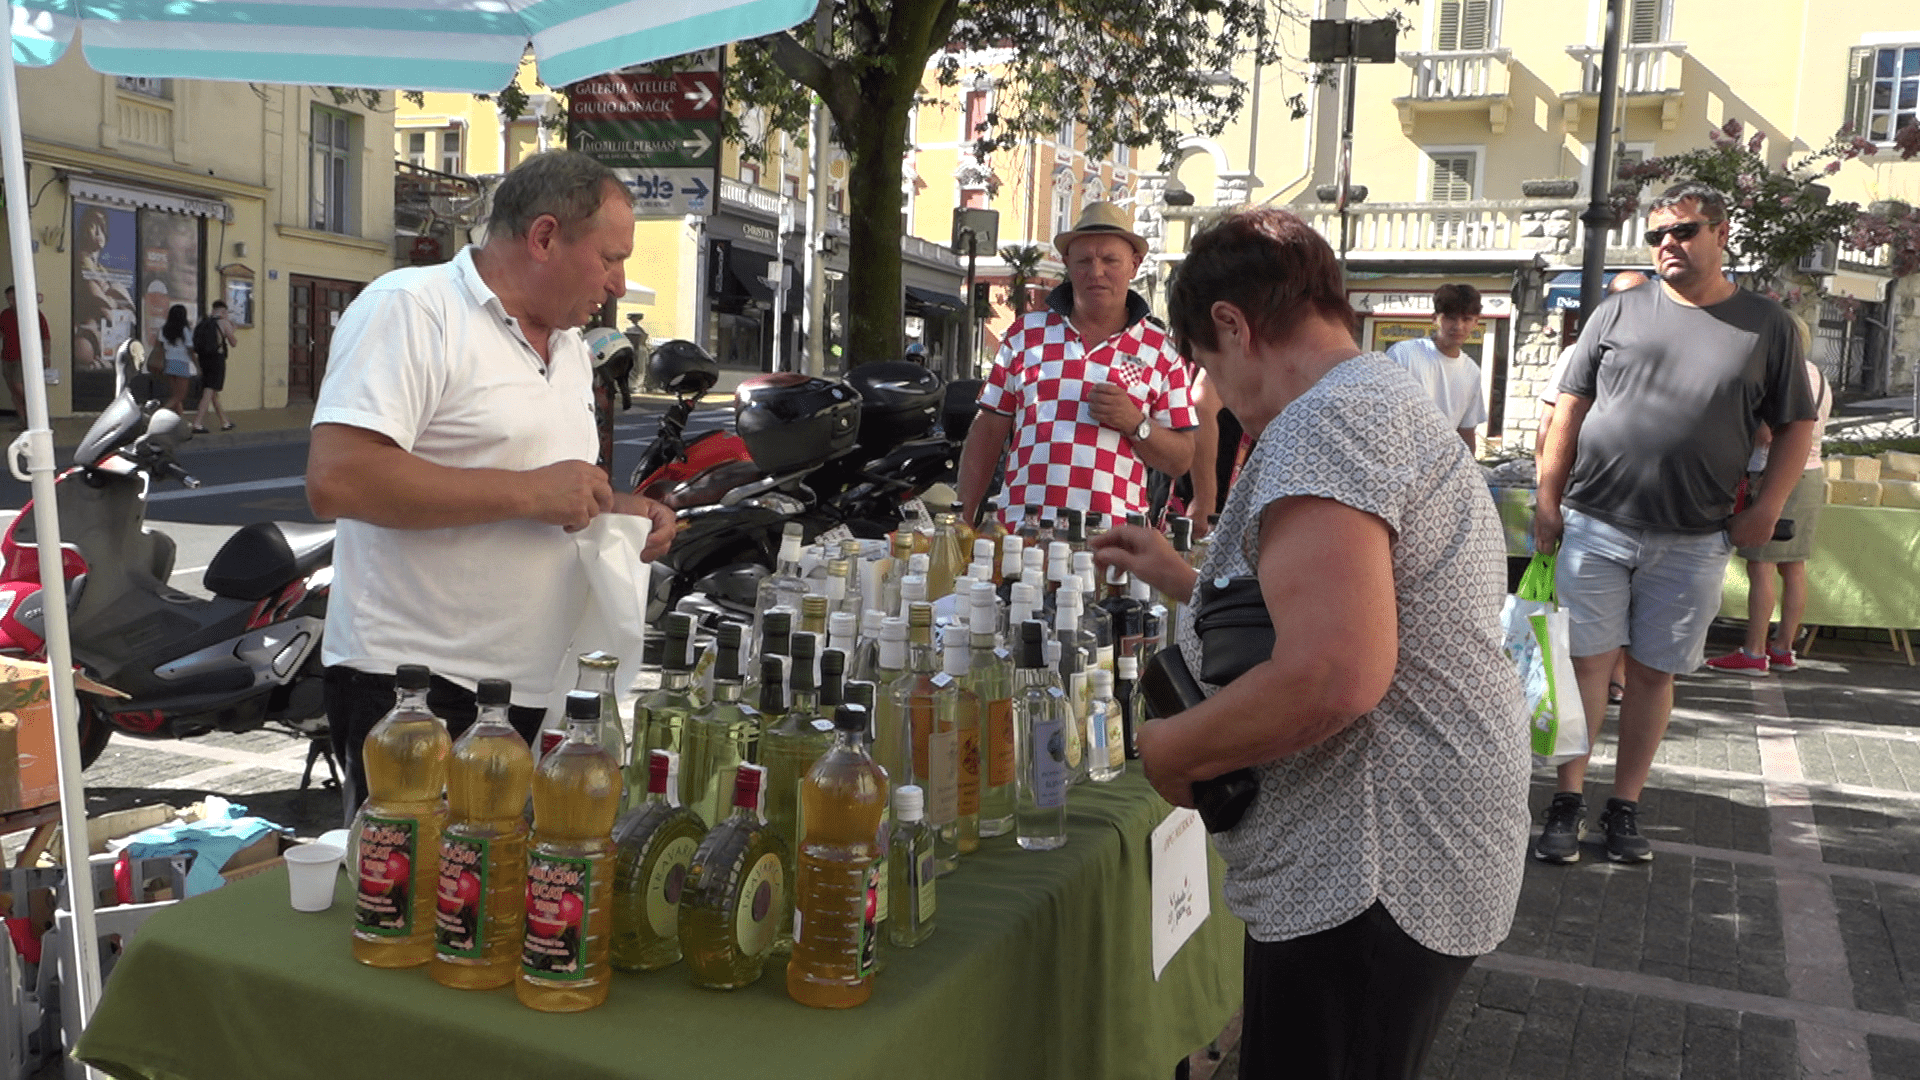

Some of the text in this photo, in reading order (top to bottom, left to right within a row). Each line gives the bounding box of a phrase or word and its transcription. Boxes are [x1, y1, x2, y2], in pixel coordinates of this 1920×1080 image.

[575, 81, 678, 95] GALERIJA ATELIER
[574, 101, 617, 114] GIULIO
[624, 175, 674, 199] ble
